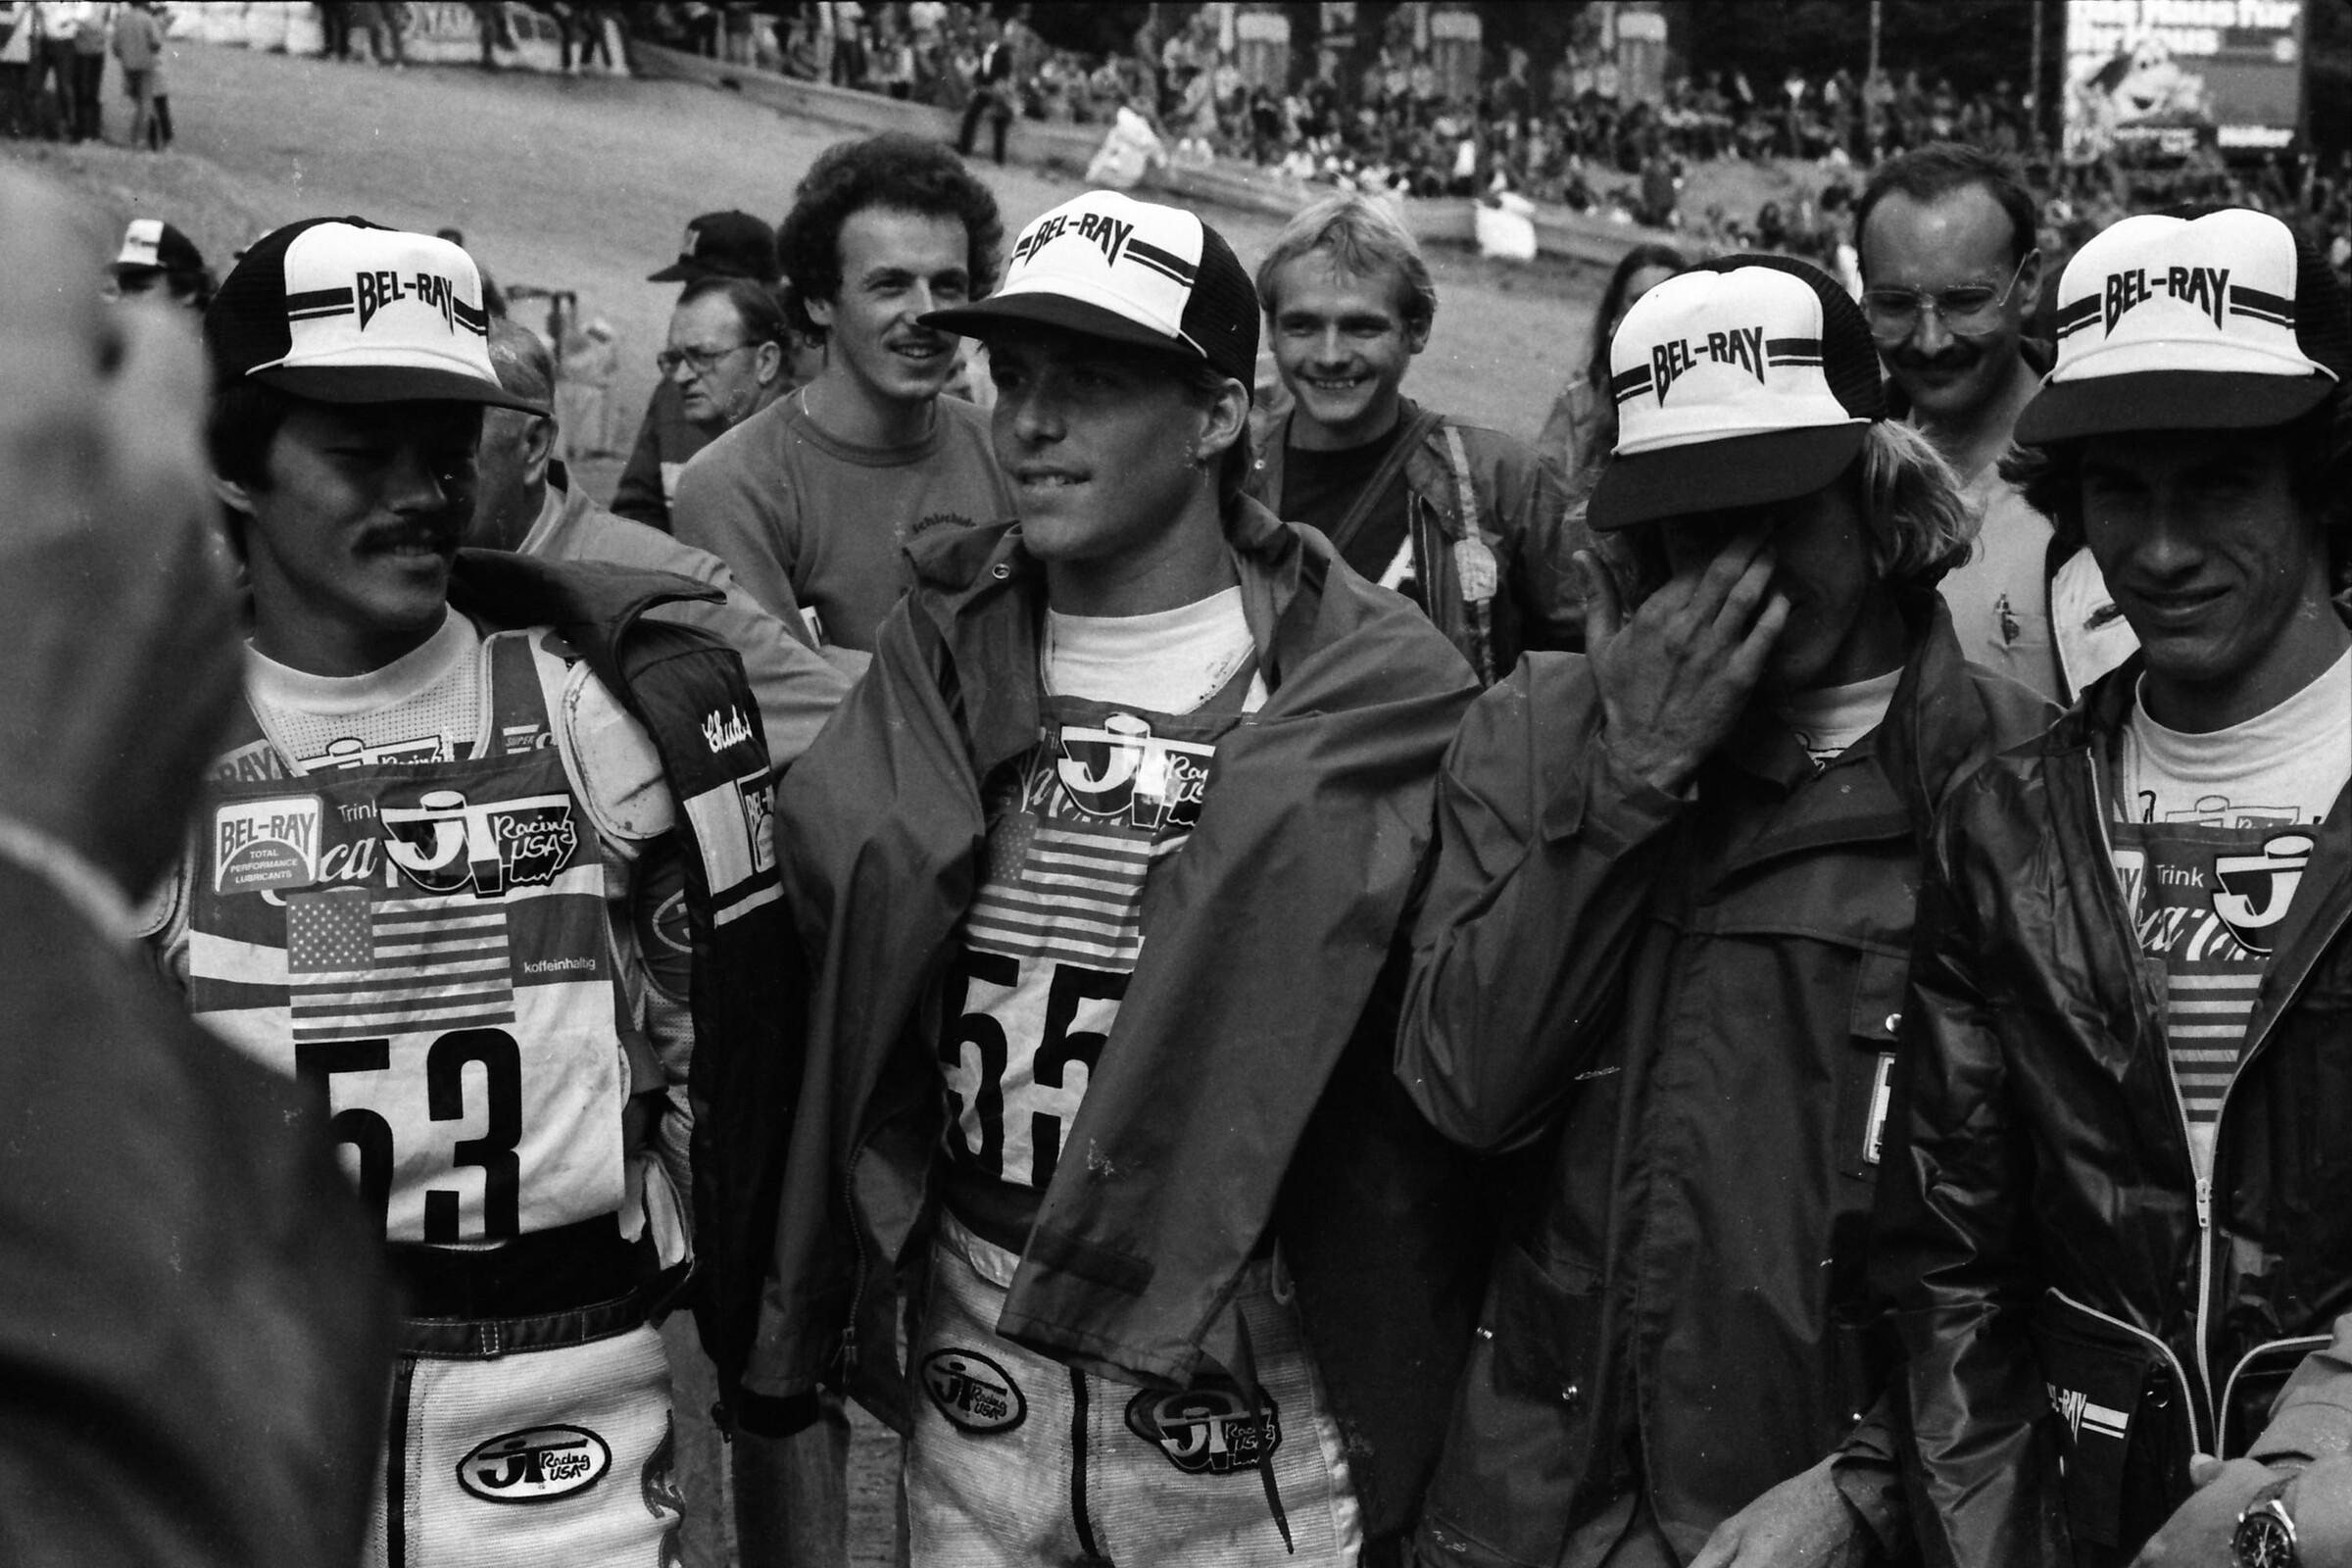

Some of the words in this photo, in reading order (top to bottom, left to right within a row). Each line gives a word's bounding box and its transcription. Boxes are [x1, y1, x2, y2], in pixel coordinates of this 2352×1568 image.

[1024, 213, 1135, 268] BEL-RAY
[356, 270, 455, 336] BEL-RAY
[2104, 266, 2230, 341] BEL-RAY
[1652, 326, 1765, 409] BEL-RAY
[220, 812, 317, 862] BEL-RAY
[493, 813, 575, 844] Racing
[249, 849, 280, 859] TOTAL
[512, 834, 559, 861] USA
[230, 858, 299, 874] PERFORMANCE
[234, 870, 293, 885] LUBRICANTS
[2156, 863, 2205, 889] Trink
[523, 956, 597, 974] koffeinhaltig
[294, 1027, 523, 1243] 53
[2046, 1382, 2087, 1444] L-RAY
[541, 1451, 591, 1471] Racing
[550, 1467, 582, 1481] USA
